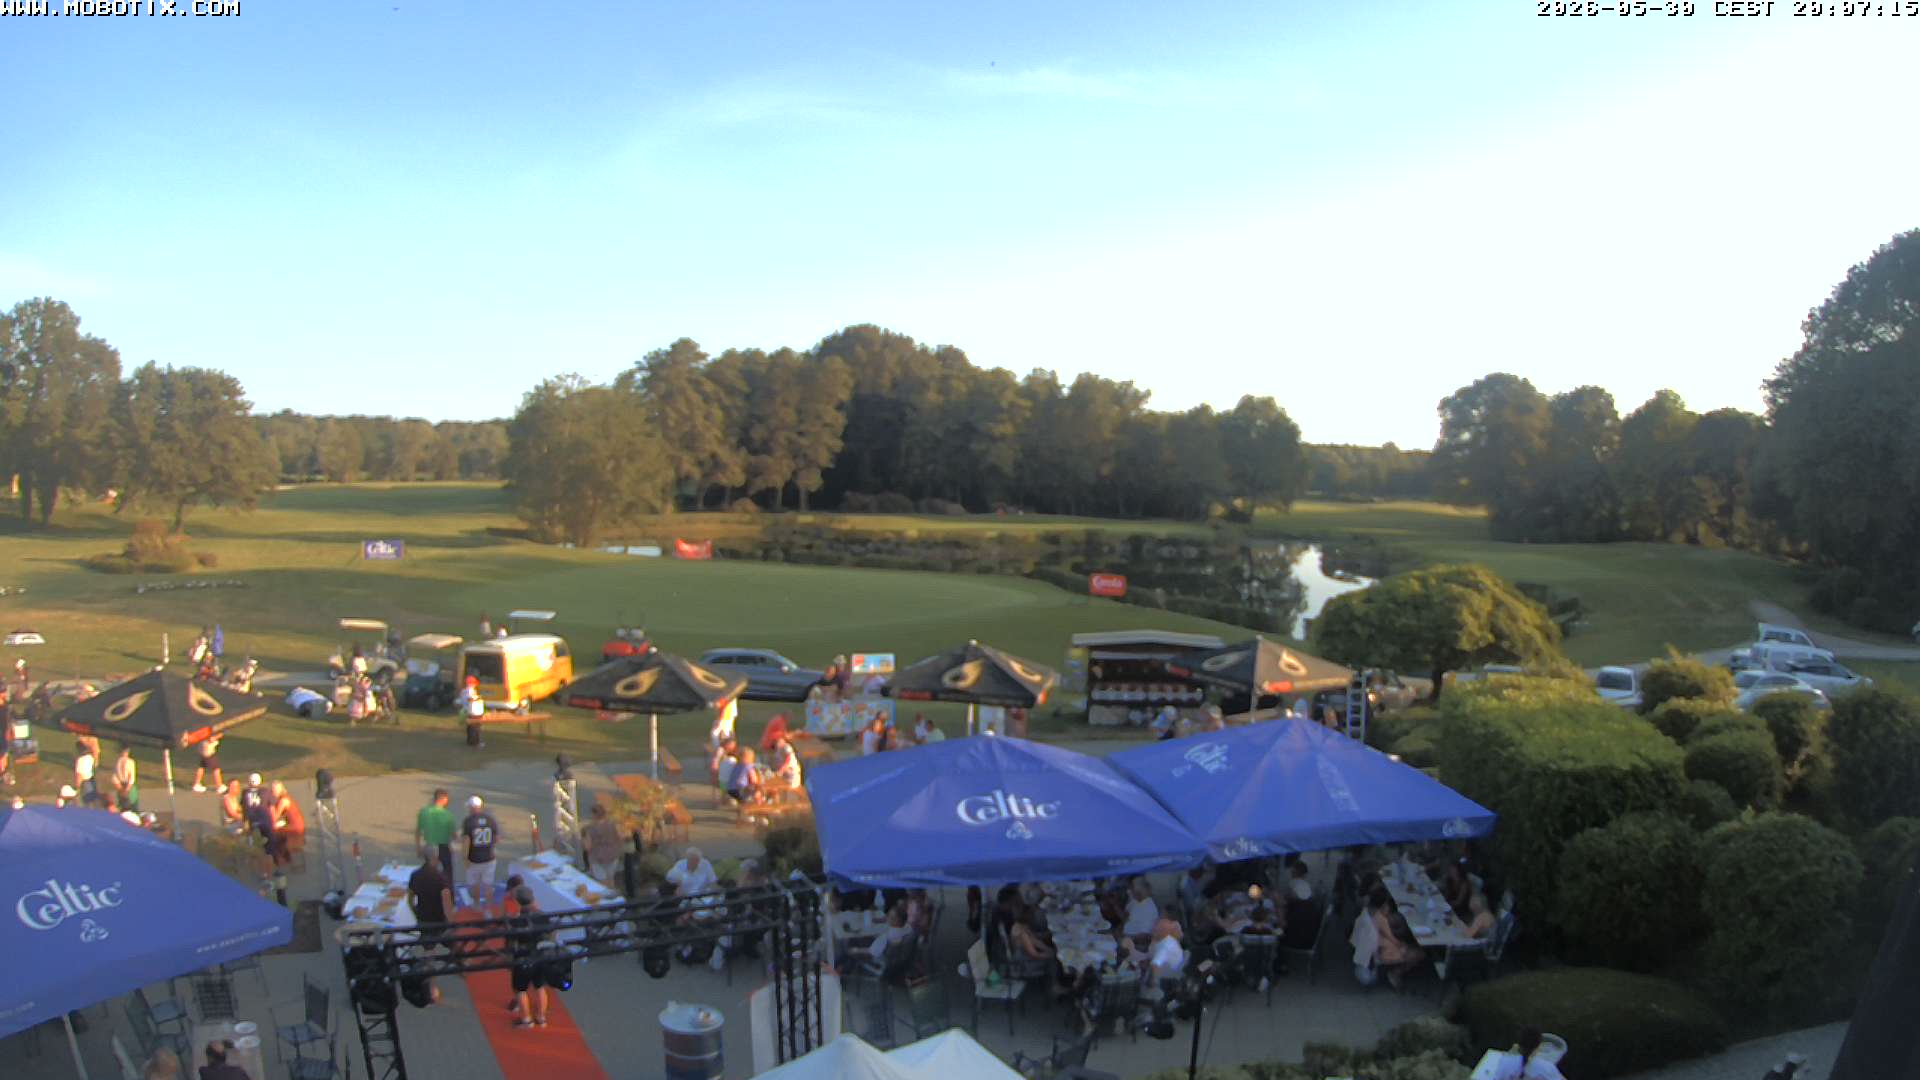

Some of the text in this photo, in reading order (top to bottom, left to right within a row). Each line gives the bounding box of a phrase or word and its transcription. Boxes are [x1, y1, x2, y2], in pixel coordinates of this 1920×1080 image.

[957, 789, 1061, 825] Celtic
[474, 828, 492, 844] 20
[17, 878, 123, 931] Celtic
